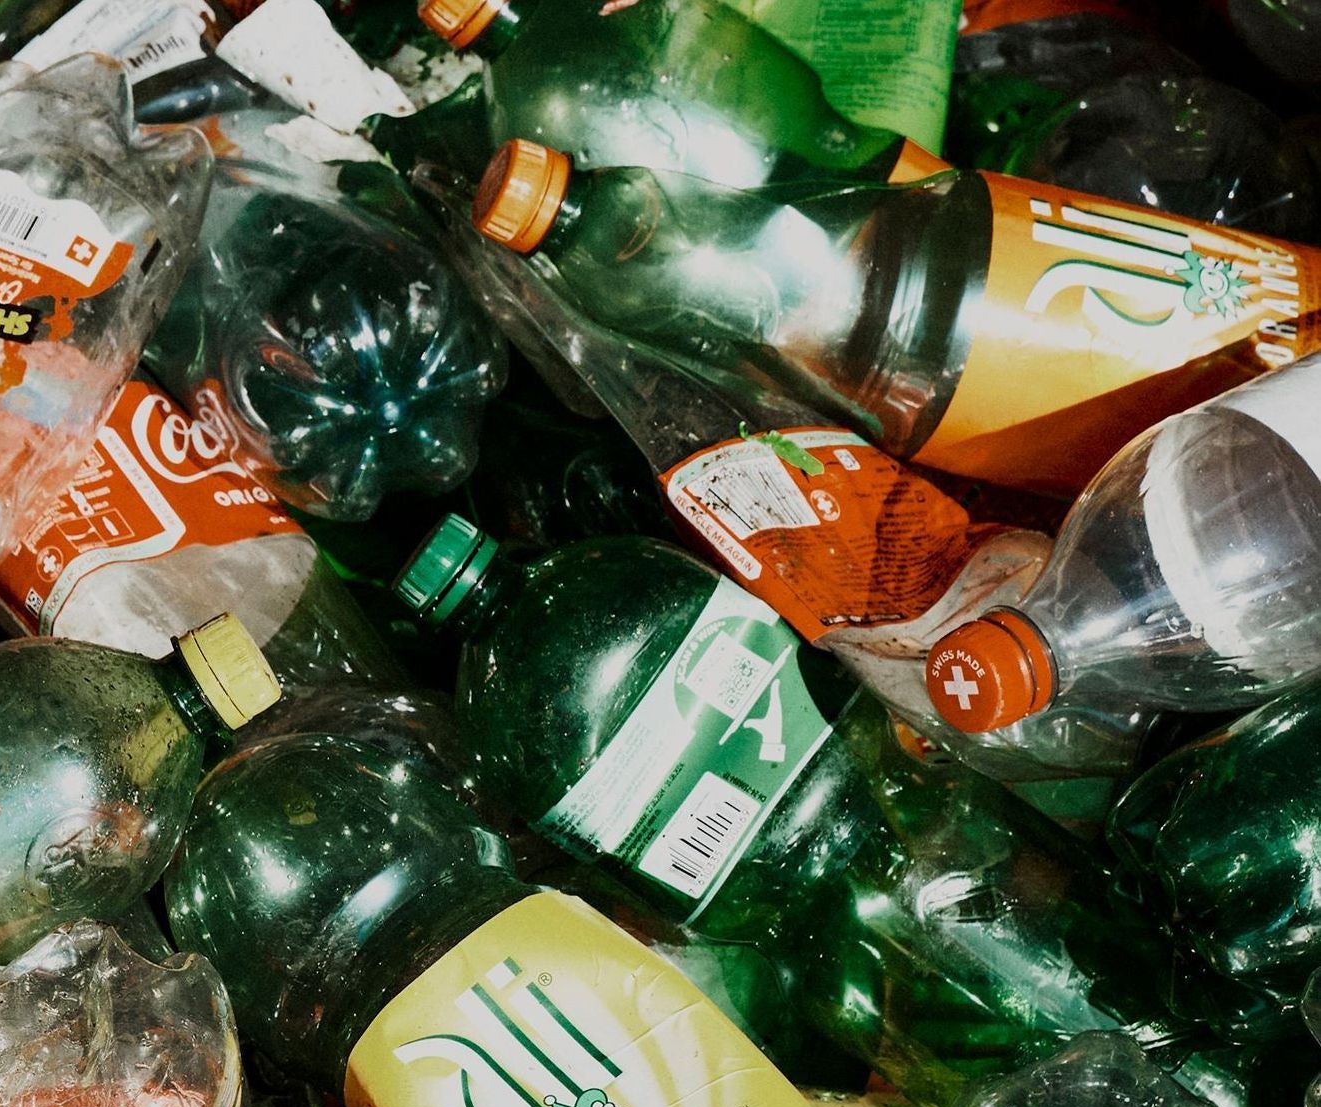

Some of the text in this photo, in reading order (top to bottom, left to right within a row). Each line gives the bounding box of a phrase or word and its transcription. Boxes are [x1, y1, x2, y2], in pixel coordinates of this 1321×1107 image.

[1255, 246, 1300, 368] ORANGE
[671, 494, 755, 574] RECYCLE ME AGAIN
[931, 649, 985, 678] SWISS MADE
